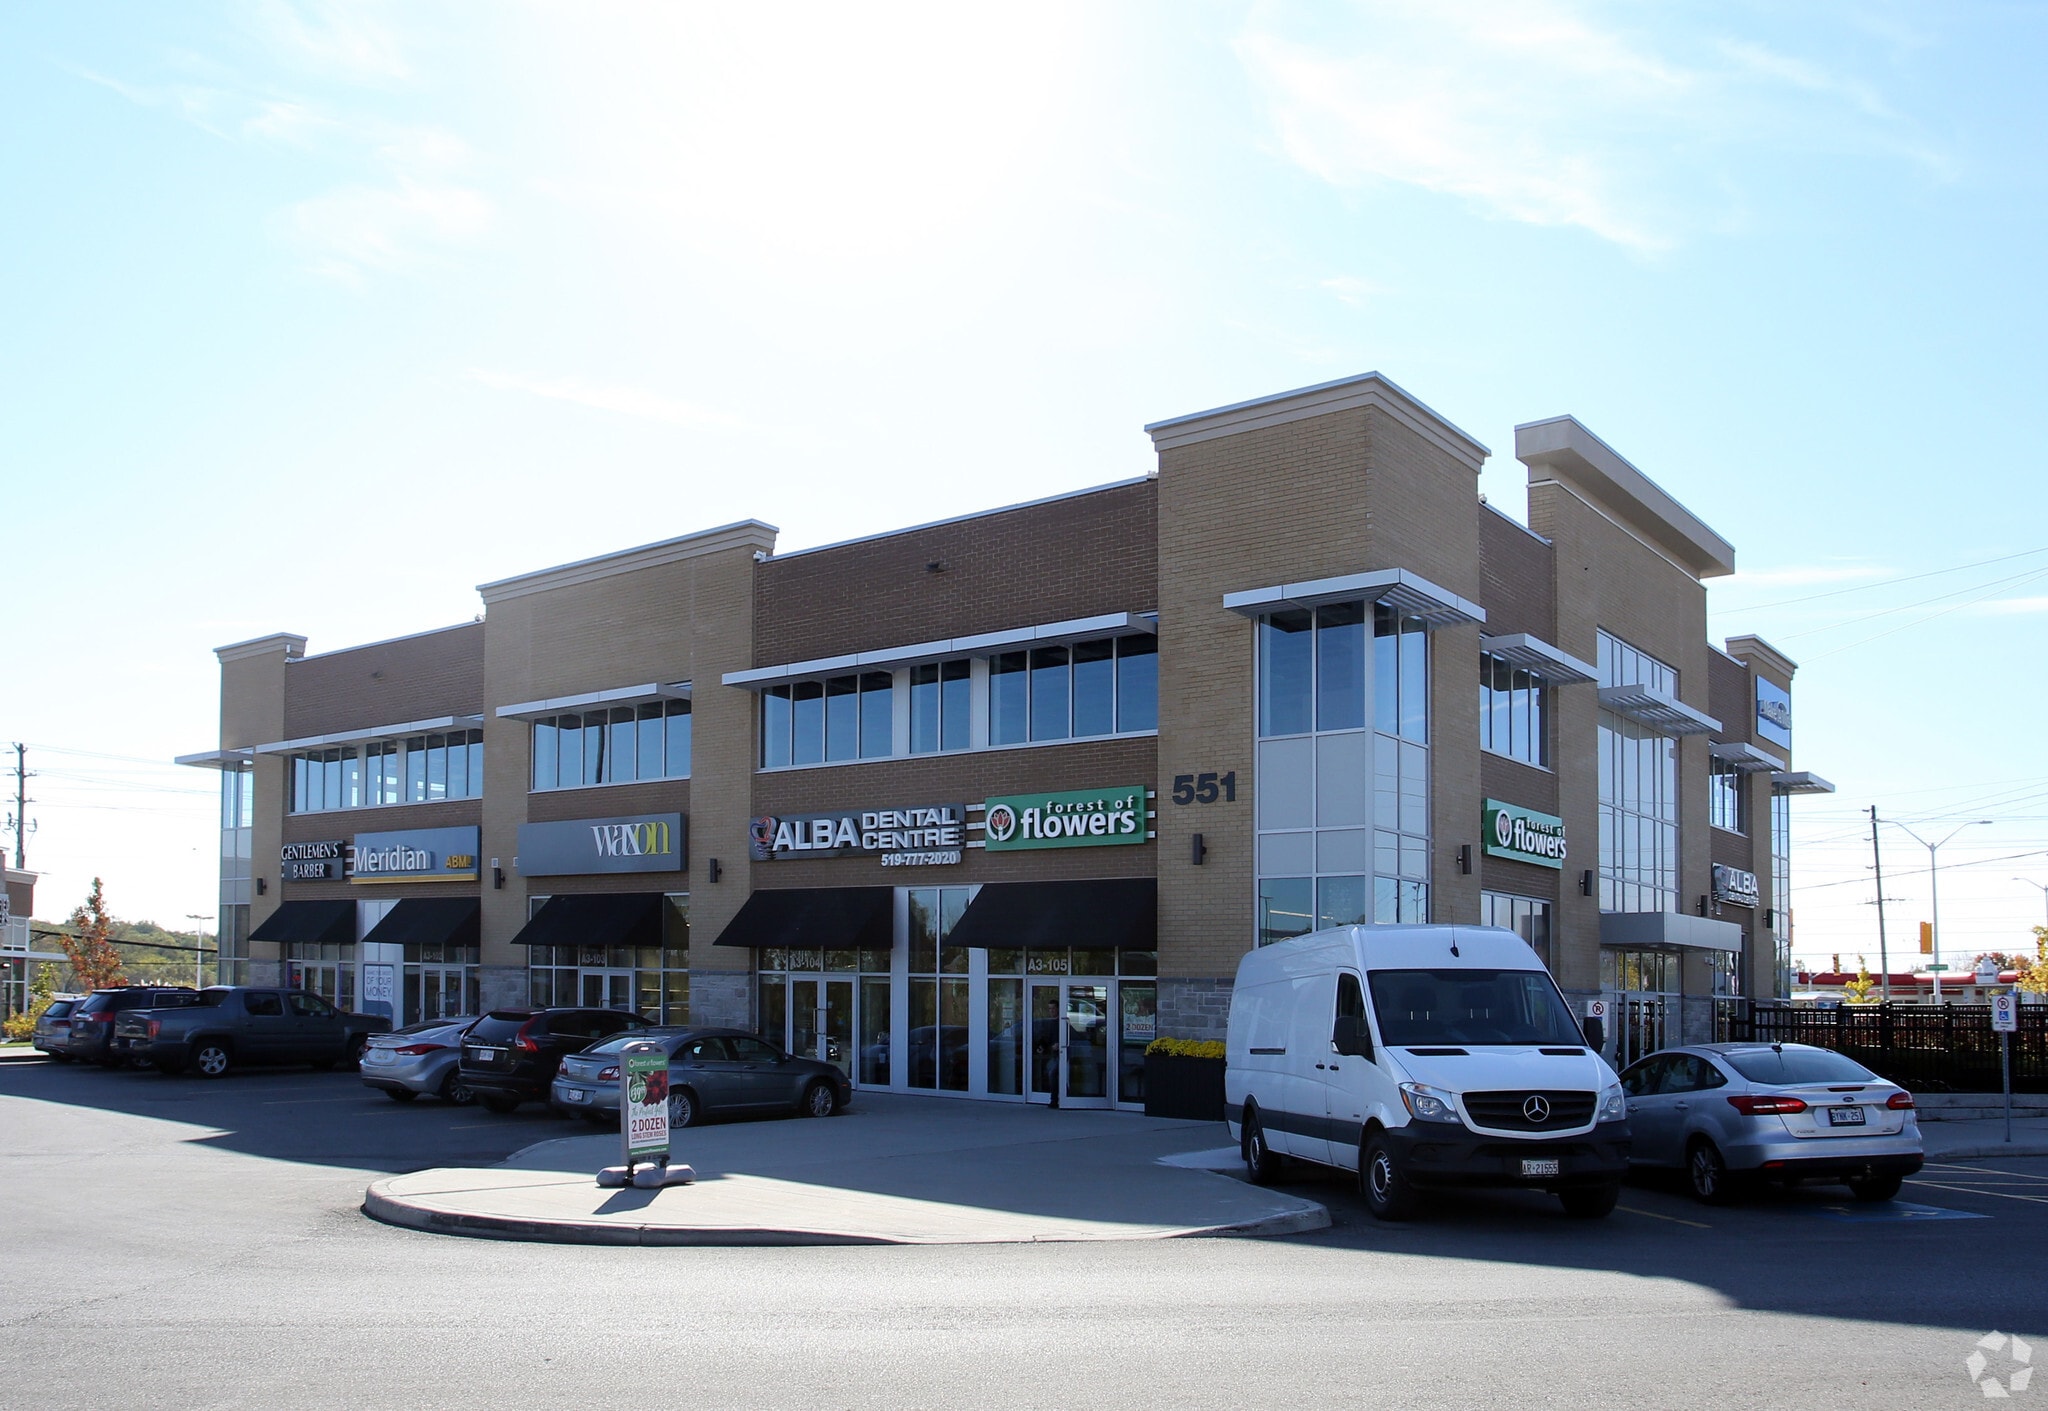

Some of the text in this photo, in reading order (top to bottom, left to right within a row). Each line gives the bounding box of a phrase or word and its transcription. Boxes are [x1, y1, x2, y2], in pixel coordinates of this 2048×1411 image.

[1172, 771, 1236, 806] 551
[1046, 795, 1134, 814] forest of
[862, 808, 959, 830] DENTAL
[1020, 807, 1136, 839] flowers
[1526, 816, 1566, 837] forest of
[772, 817, 862, 851] ALBA
[862, 828, 959, 850] CENTRE
[1514, 818, 1567, 860] flowers
[281, 842, 338, 861] GENTLEMEN'S
[353, 845, 427, 873] Meridian
[445, 855, 468, 868] ABM
[881, 852, 960, 866] 519-777-2020
[293, 863, 325, 879] BARBER
[1729, 870, 1759, 896] ALBA
[790, 956, 821, 968] A3-104
[1027, 957, 1068, 972] A3-105
[631, 1117, 666, 1132] 2 DOZEN
